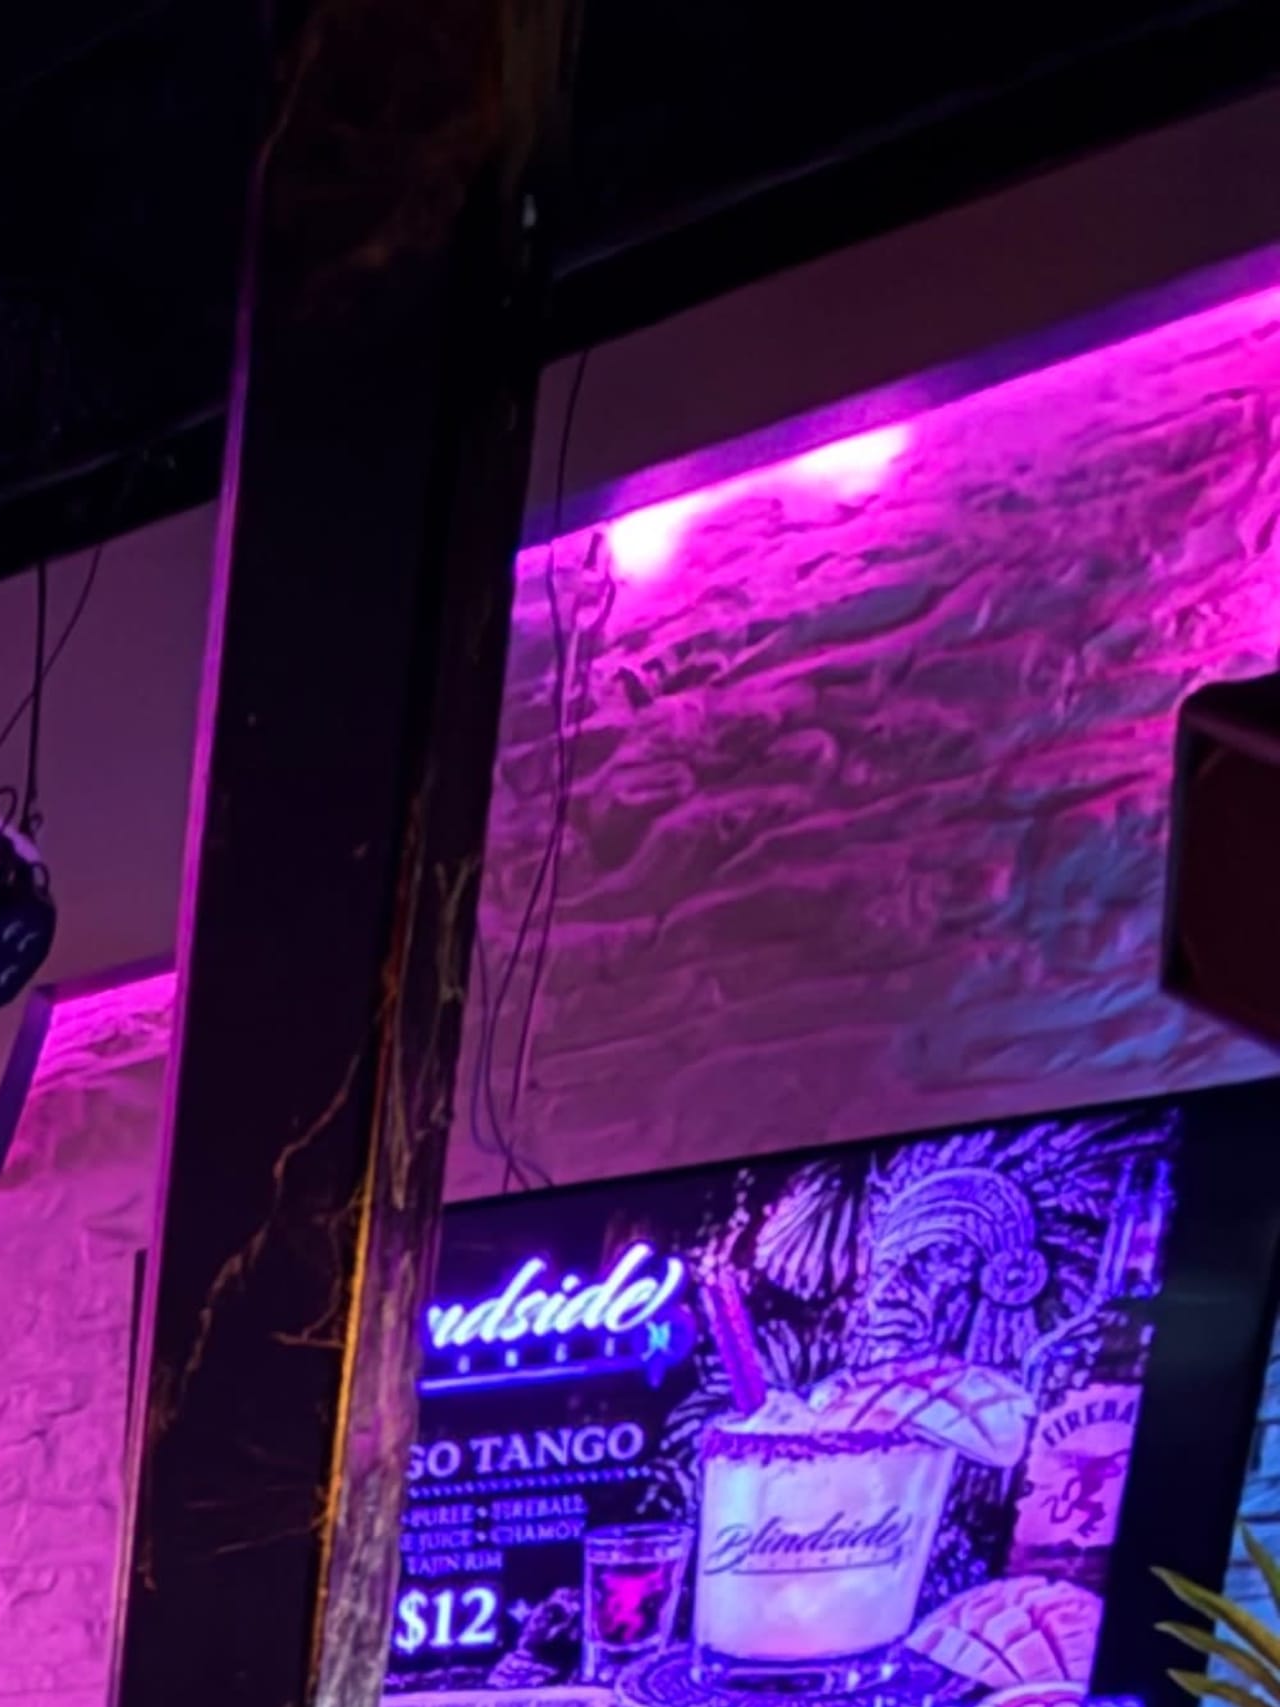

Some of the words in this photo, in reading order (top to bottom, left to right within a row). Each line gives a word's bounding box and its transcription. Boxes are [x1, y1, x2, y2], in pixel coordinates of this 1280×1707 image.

[470, 1421, 645, 1475] TANGO
[417, 1528, 474, 1553] JUICE
[490, 1518, 587, 1546] CHAMOY
[704, 1505, 914, 1575] Blindside
[394, 1586, 498, 1655] $12
